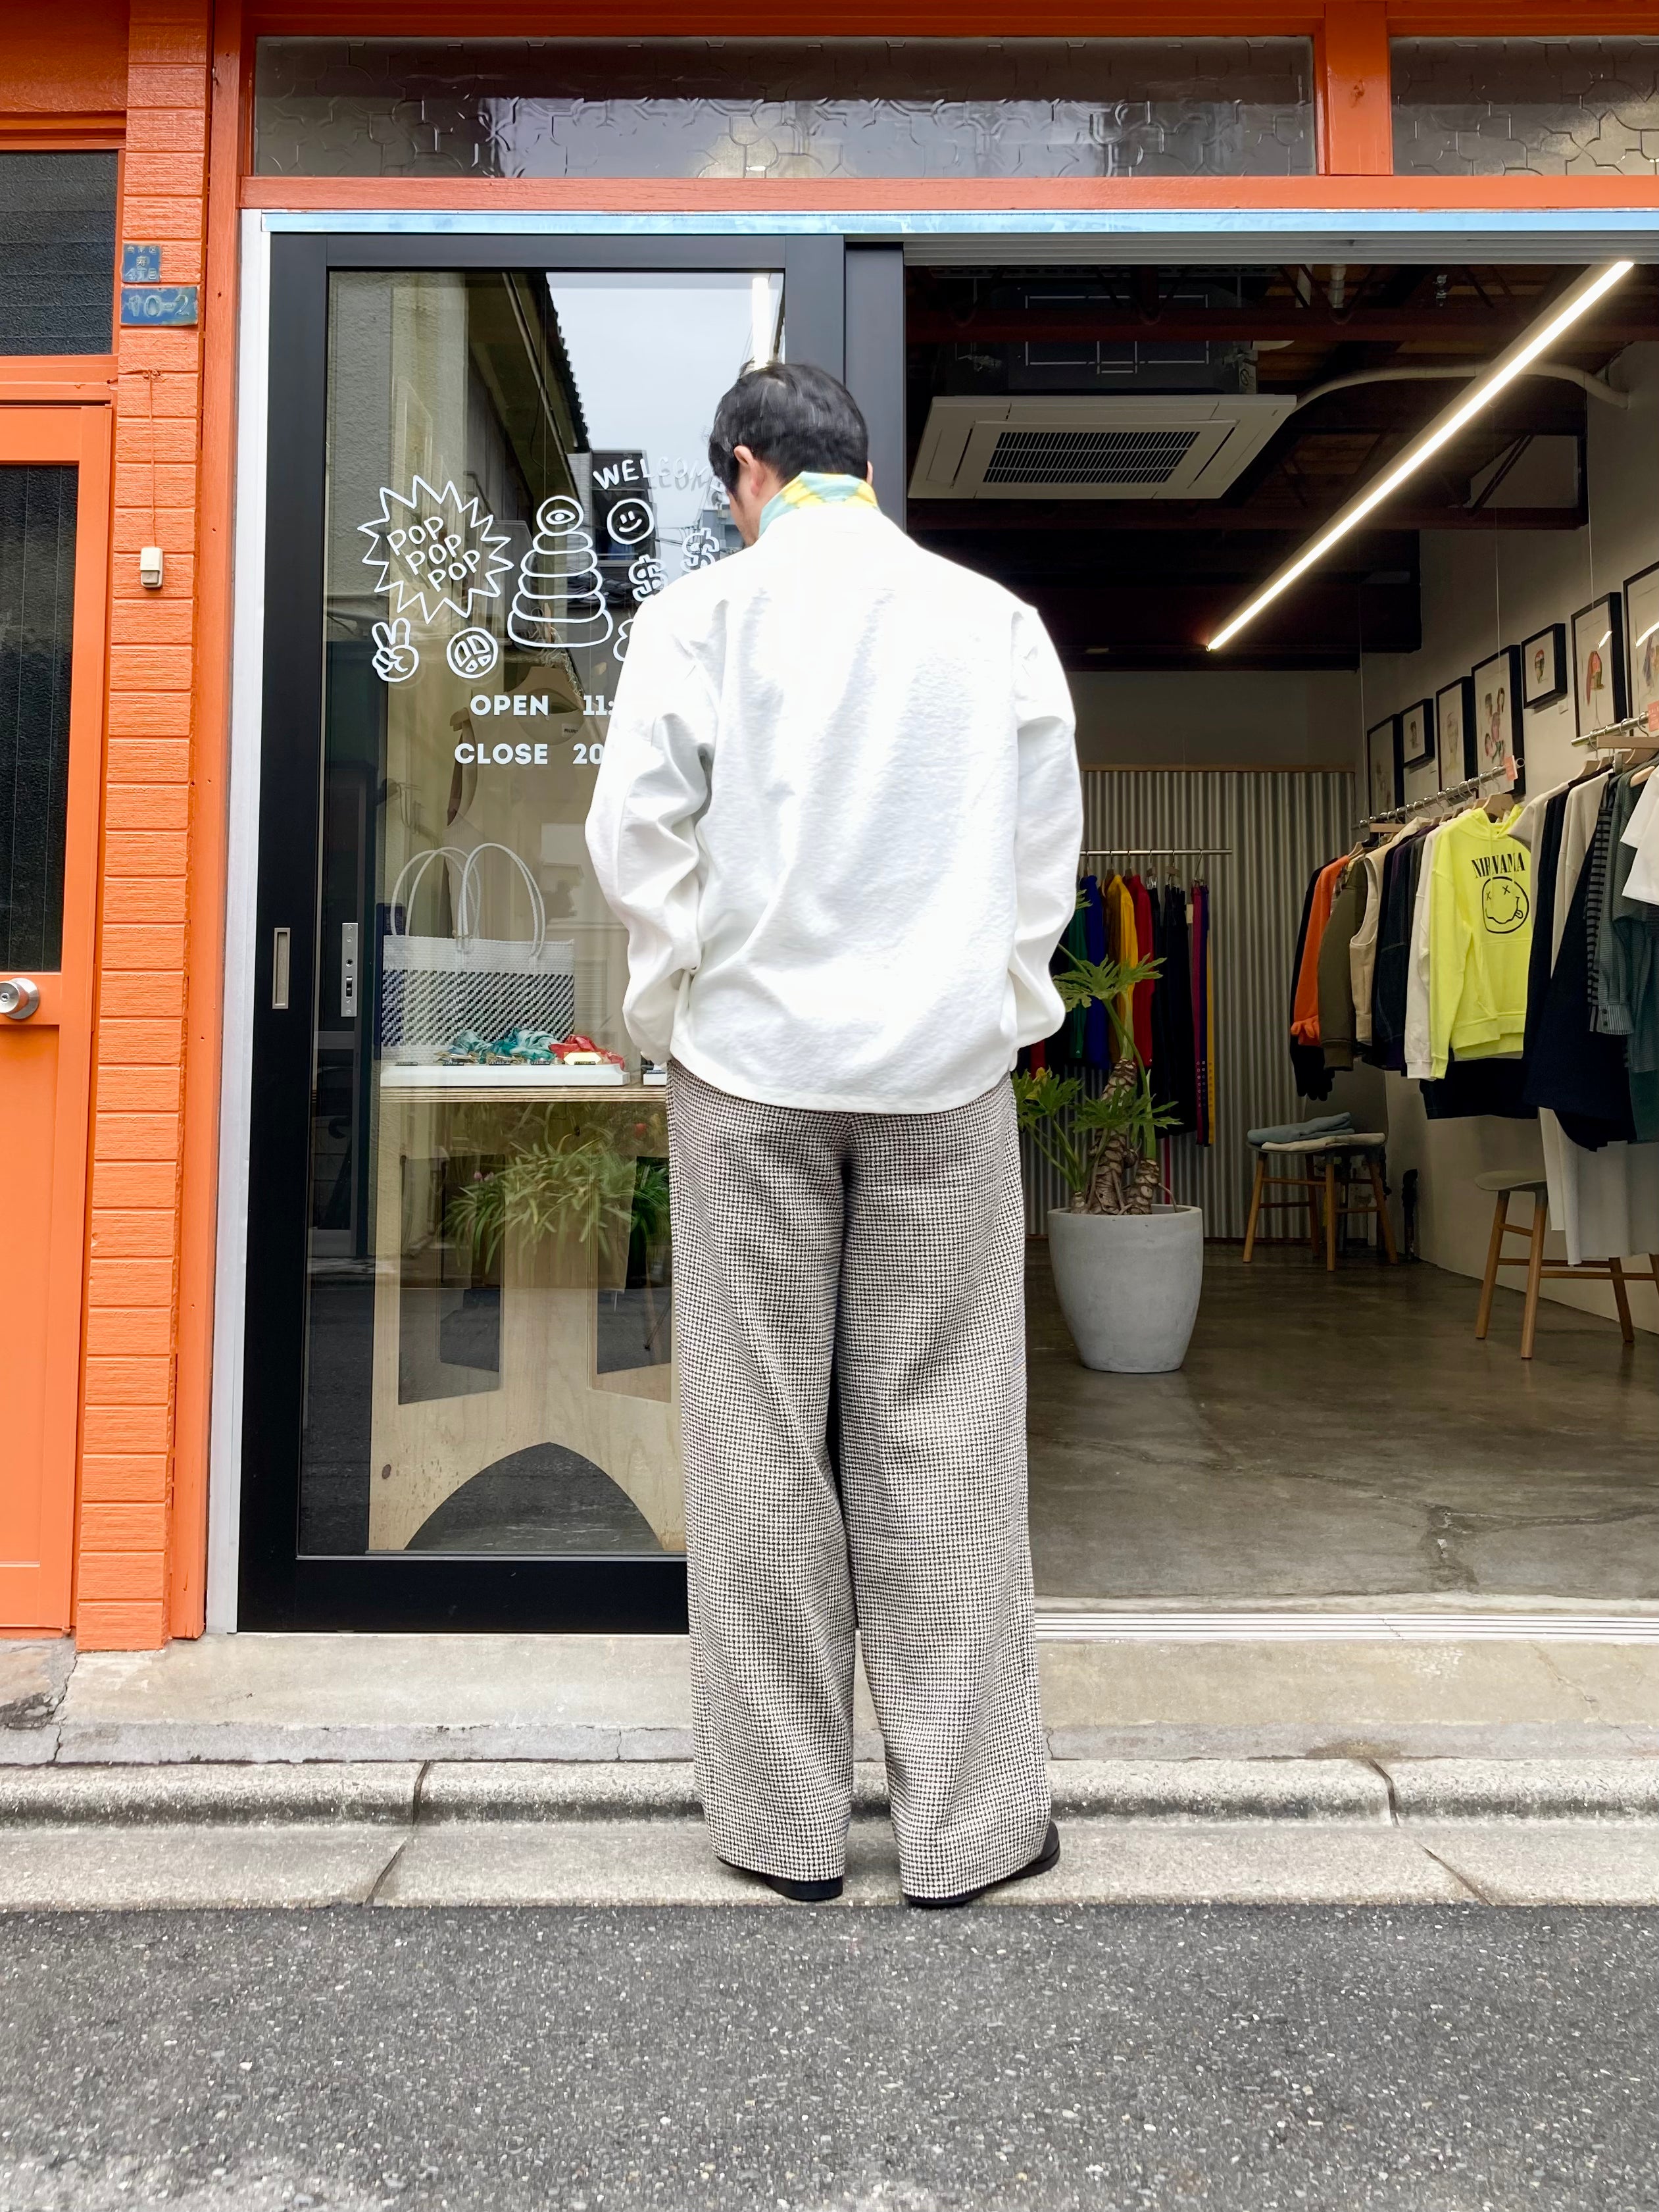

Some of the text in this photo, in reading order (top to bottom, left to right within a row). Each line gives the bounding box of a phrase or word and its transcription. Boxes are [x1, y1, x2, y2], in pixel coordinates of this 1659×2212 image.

[128, 294, 191, 317] 10-2
[387, 516, 444, 557] POP
[405, 534, 462, 576] POP
[427, 549, 481, 593] POP
[470, 694, 549, 716] OPEN
[454, 743, 548, 765] CLOSE
[1471, 852, 1526, 879] NIRVANA
